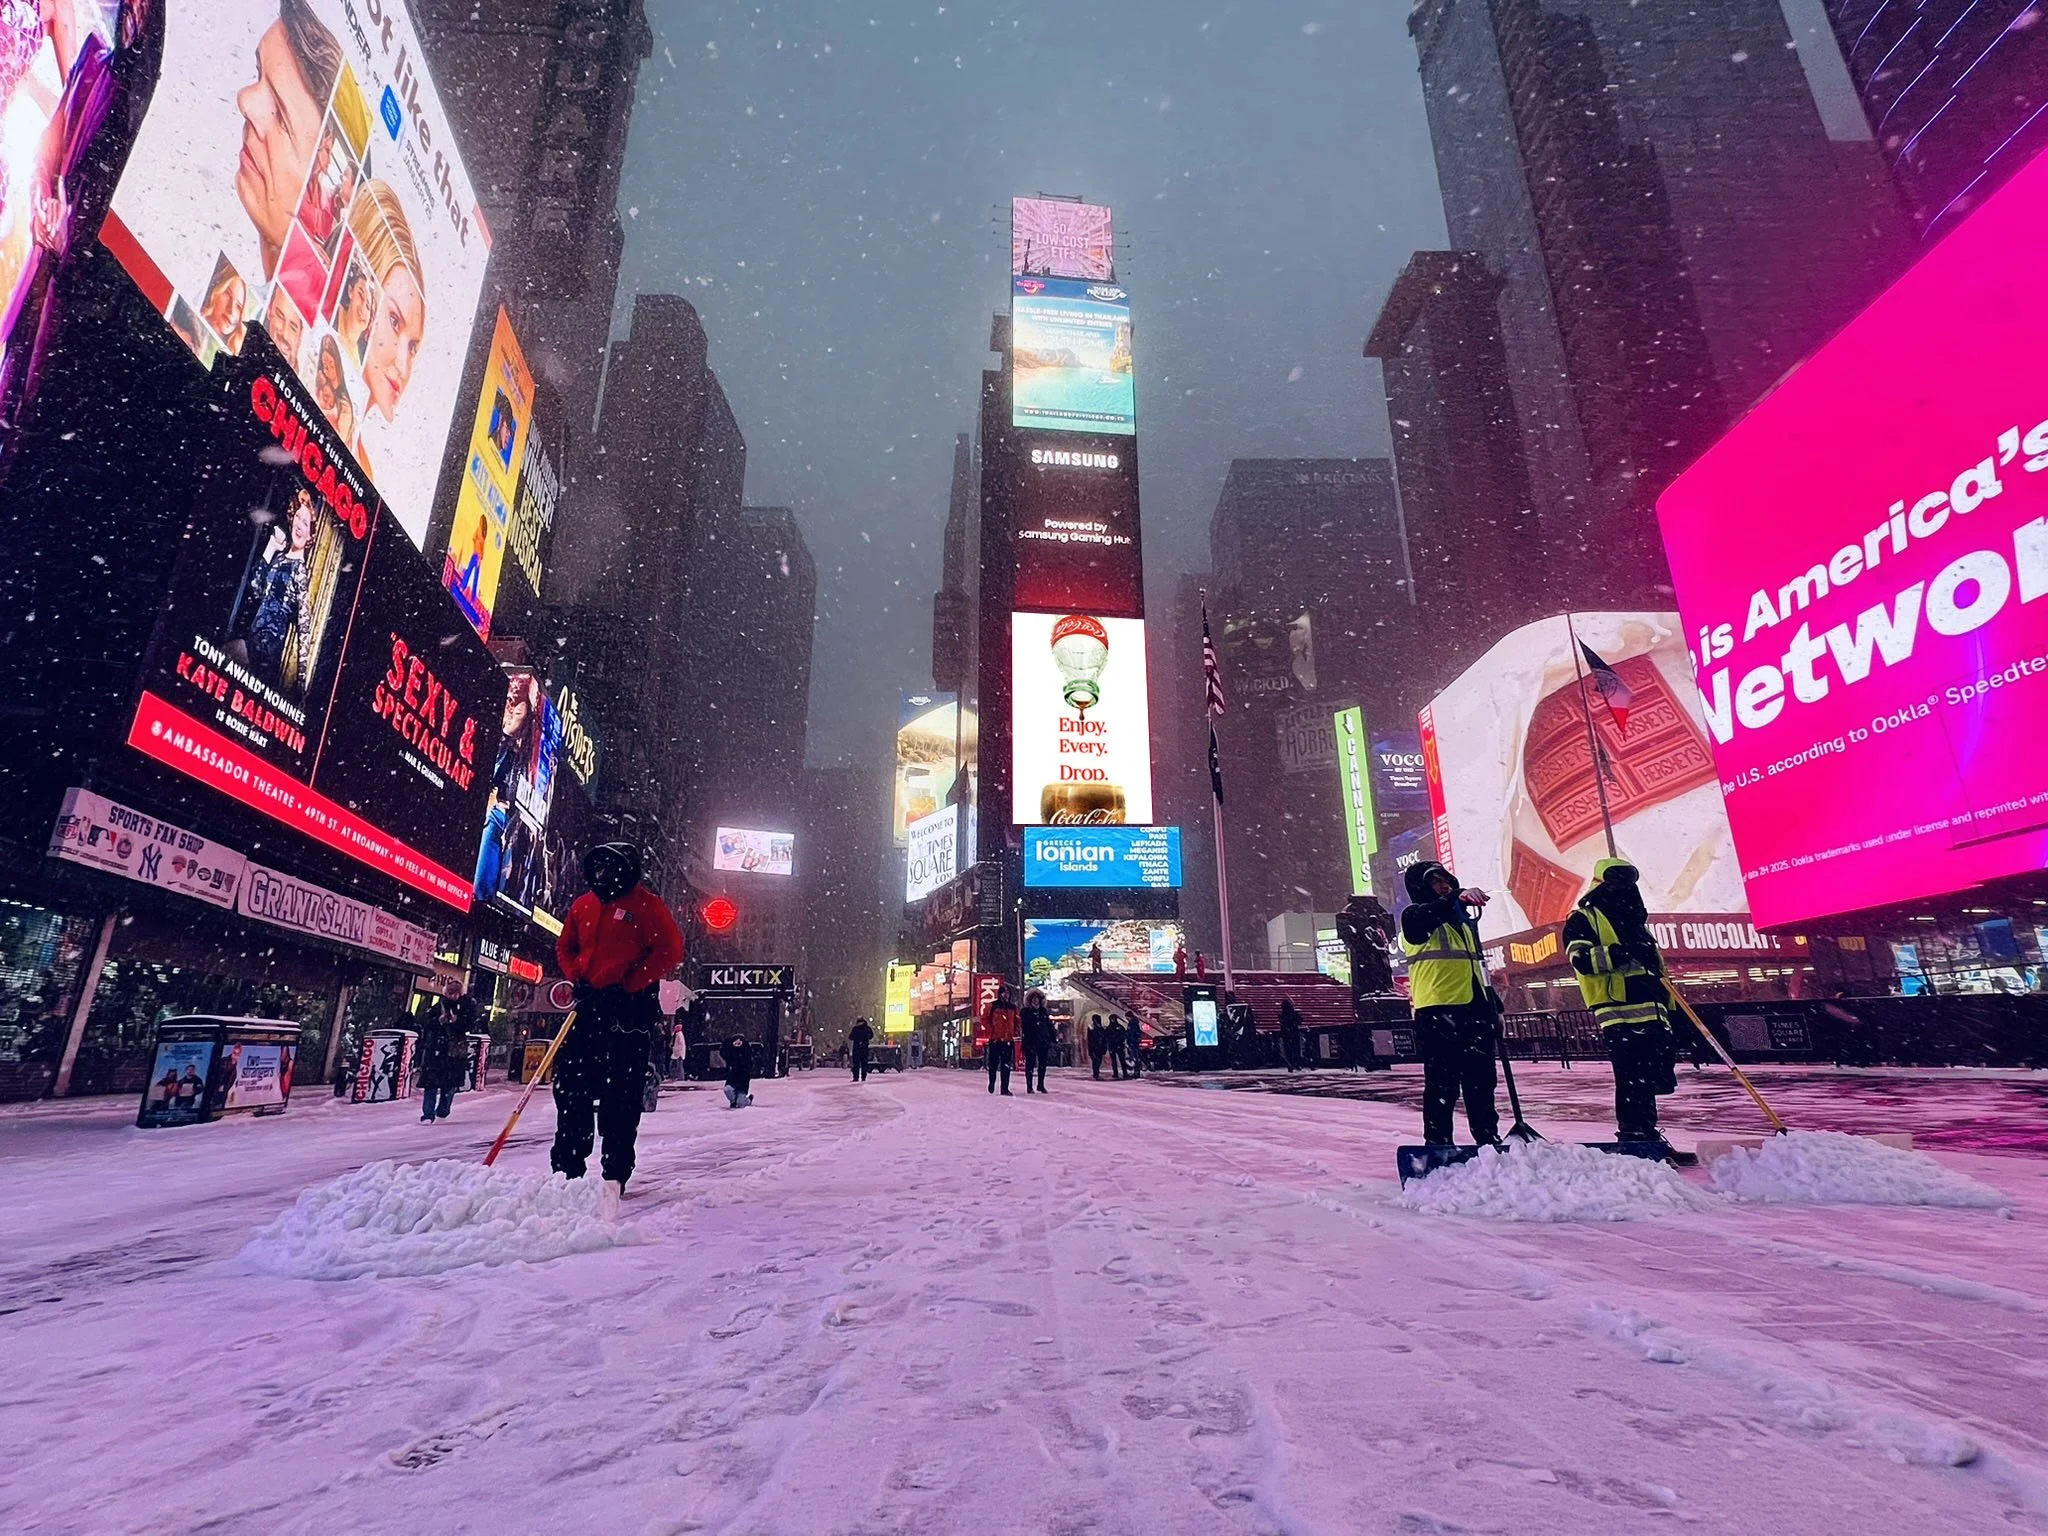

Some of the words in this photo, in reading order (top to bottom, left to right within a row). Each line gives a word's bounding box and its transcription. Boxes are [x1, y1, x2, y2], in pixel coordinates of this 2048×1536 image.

[394, 44, 431, 154] like
[433, 150, 469, 249] that
[1036, 233, 1059, 246] LOW
[1062, 235, 1090, 249] COST
[1053, 223, 1067, 235] 50
[273, 373, 325, 444] BROADWAY'S
[325, 443, 344, 469] SURE
[251, 376, 368, 540] CHICAGO
[1031, 449, 1119, 469] SAMSUNG
[520, 484, 543, 550] BEST
[1044, 519, 1093, 531] Powered
[1094, 521, 1107, 534] by
[1018, 530, 1068, 543] Samsung
[1069, 532, 1112, 546] Gaming
[1700, 622, 1734, 667] is
[194, 635, 226, 667] TONY
[264, 687, 306, 726] NOMINEE
[176, 651, 229, 702] KATE
[231, 689, 306, 754] BALDWIN
[215, 708, 225, 722] IS
[247, 729, 268, 748] HART
[459, 717, 477, 765] &
[1059, 717, 1107, 736] Enjoy.
[1059, 739, 1108, 757] Every.
[1640, 744, 1703, 785] HERSHEY'S
[1736, 767, 1765, 788] U.S.
[1767, 736, 1845, 776] according
[1848, 728, 1868, 743] to
[163, 728, 250, 784] AMBASSADOR
[253, 774, 295, 808] THEATRE
[304, 805, 327, 825] 49TH
[327, 817, 339, 832] ST.
[341, 826, 352, 838] AT
[351, 831, 389, 858] BROADWAY
[394, 854, 405, 868] NO
[405, 859, 419, 874] FEES
[419, 867, 427, 878] AT
[427, 872, 437, 885] THE
[436, 878, 447, 891] BOX
[1346, 738, 1372, 883] CANNABIS
[109, 806, 153, 836] SPORTS
[153, 821, 178, 846] FAN
[178, 833, 204, 854] SHOP
[911, 820, 944, 840] WELCOME
[943, 816, 954, 829] TO
[927, 834, 953, 856] TIMES
[1814, 843, 1861, 861] trademarks
[1862, 835, 1883, 849] used
[1885, 828, 1912, 843] under
[1914, 818, 1949, 835] license
[1951, 811, 1972, 826] and
[1974, 797, 2028, 820] reprinted
[909, 850, 953, 885] SQUARE
[1036, 840, 1114, 862] Ionian
[1059, 861, 1099, 872] Islands
[480, 939, 499, 959] BLUE
[1509, 943, 1535, 965] ENTER
[1532, 932, 1558, 963] BELOW
[710, 969, 782, 985] KLIKTIX
[1771, 1021, 1800, 1029] TIMES
[1771, 1029, 1804, 1037] SQUARE
[354, 1039, 375, 1100] CHICAGO
